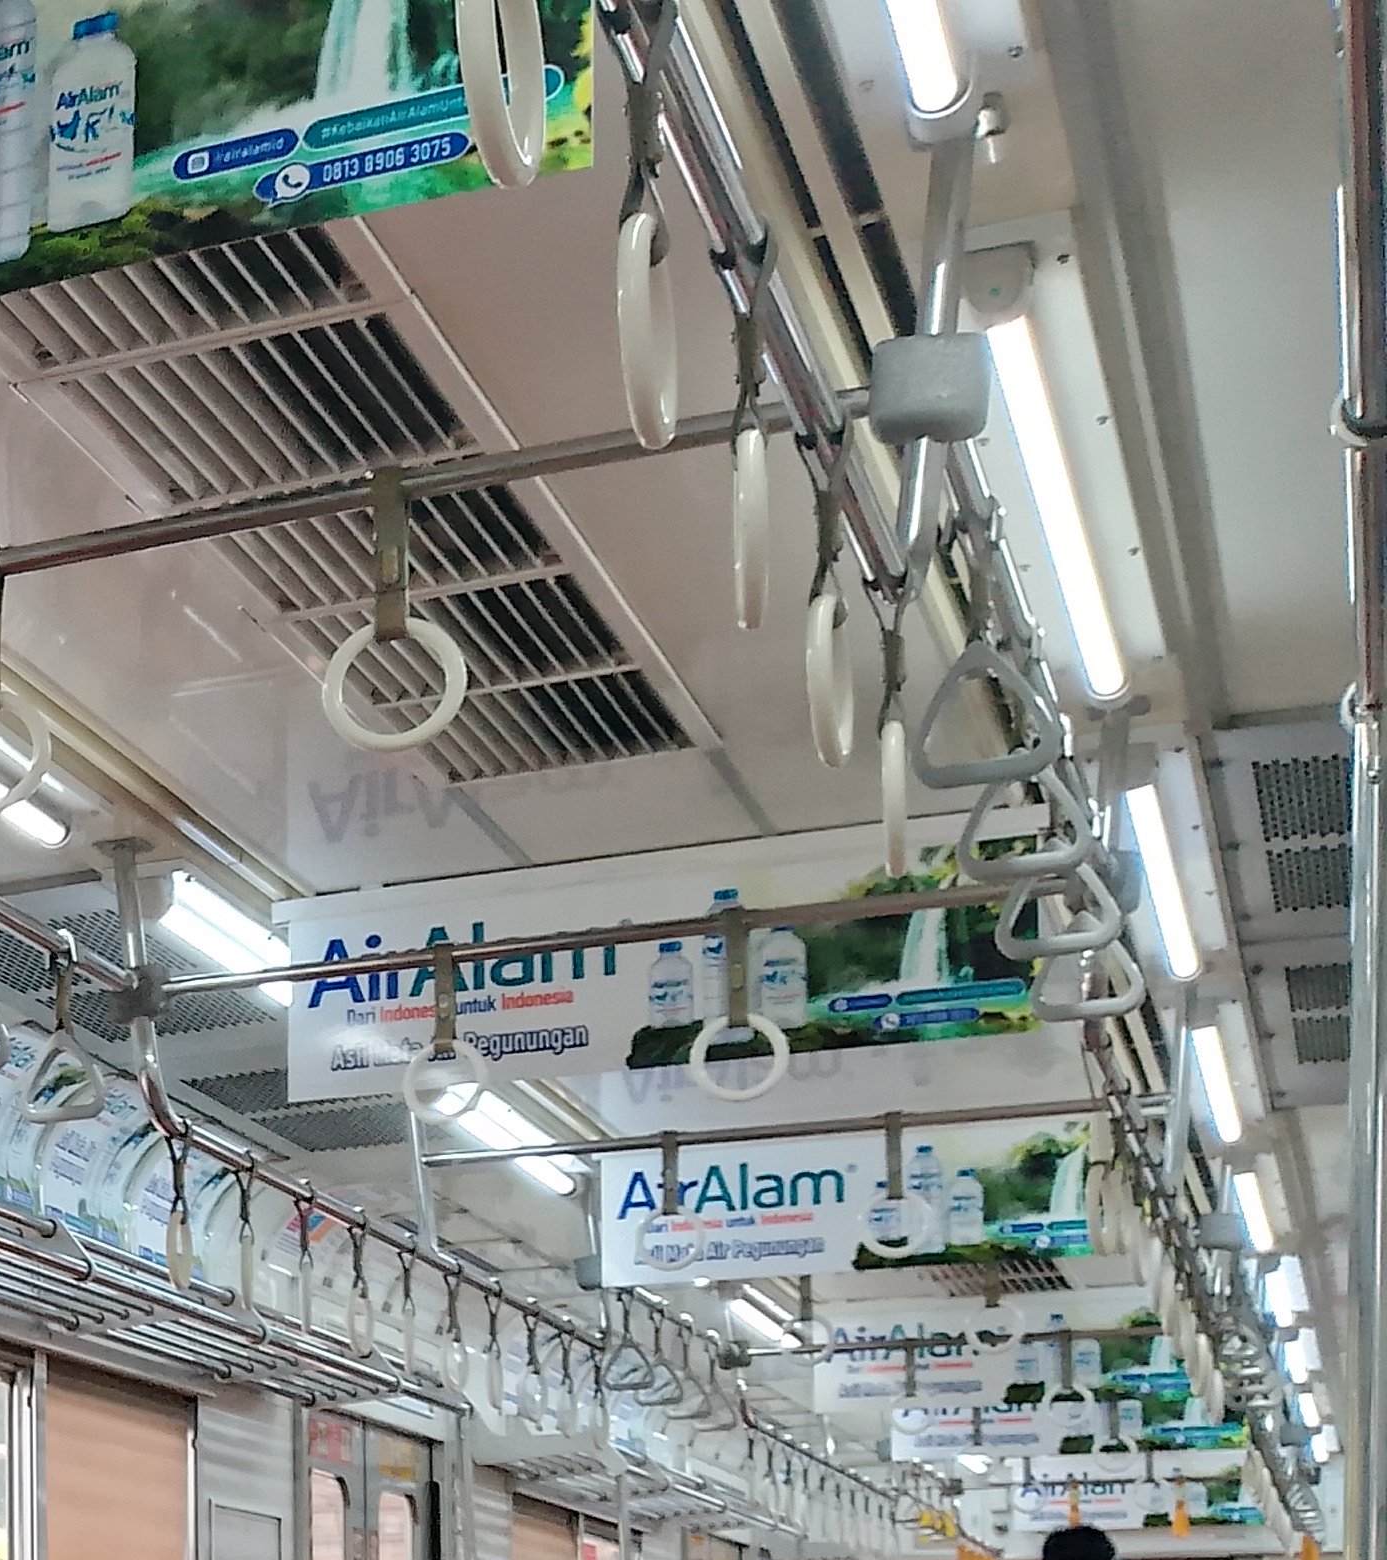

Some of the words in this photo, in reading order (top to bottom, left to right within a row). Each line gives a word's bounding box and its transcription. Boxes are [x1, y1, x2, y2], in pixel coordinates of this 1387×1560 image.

[56, 82, 122, 111] AirAlam
[322, 156, 359, 184] 0813
[364, 147, 405, 173] 8906
[409, 136, 452, 164] 3075
[380, 1004, 437, 1024] Indones
[456, 995, 496, 1015] untuk
[617, 1162, 844, 1221] ArAlam
